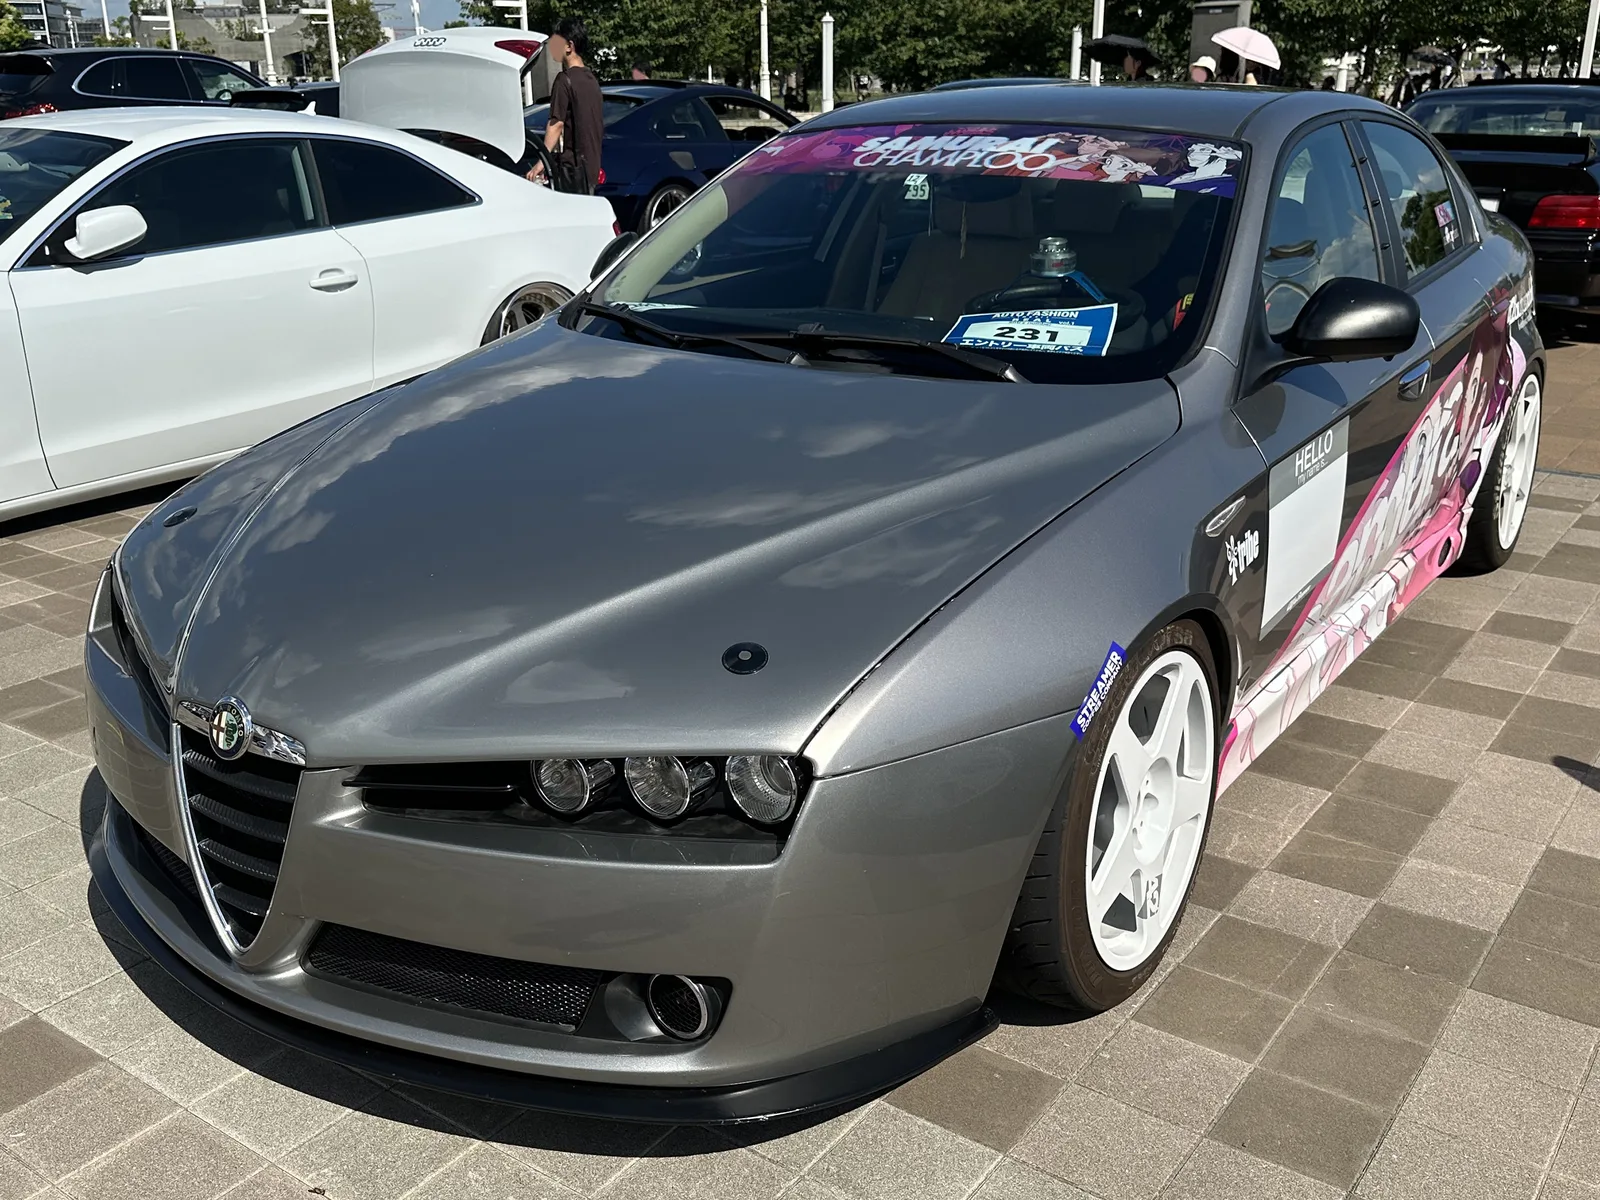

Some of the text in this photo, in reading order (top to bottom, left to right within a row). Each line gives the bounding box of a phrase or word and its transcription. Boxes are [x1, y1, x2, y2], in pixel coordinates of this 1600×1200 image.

[853, 136, 1061, 154] SAMURAI
[853, 150, 1057, 171] CHAMPLOO
[992, 311, 1024, 319] AUTO
[1025, 310, 1079, 319] FASHION
[994, 326, 1060, 342] 231
[1295, 429, 1334, 477] HELLO
[1297, 474, 1306, 486] my
[1306, 464, 1320, 479] name
[1237, 529, 1260, 574] tribe
[1077, 651, 1121, 728] STREAMER
[1082, 658, 1123, 733] COFFEE COMPANY
